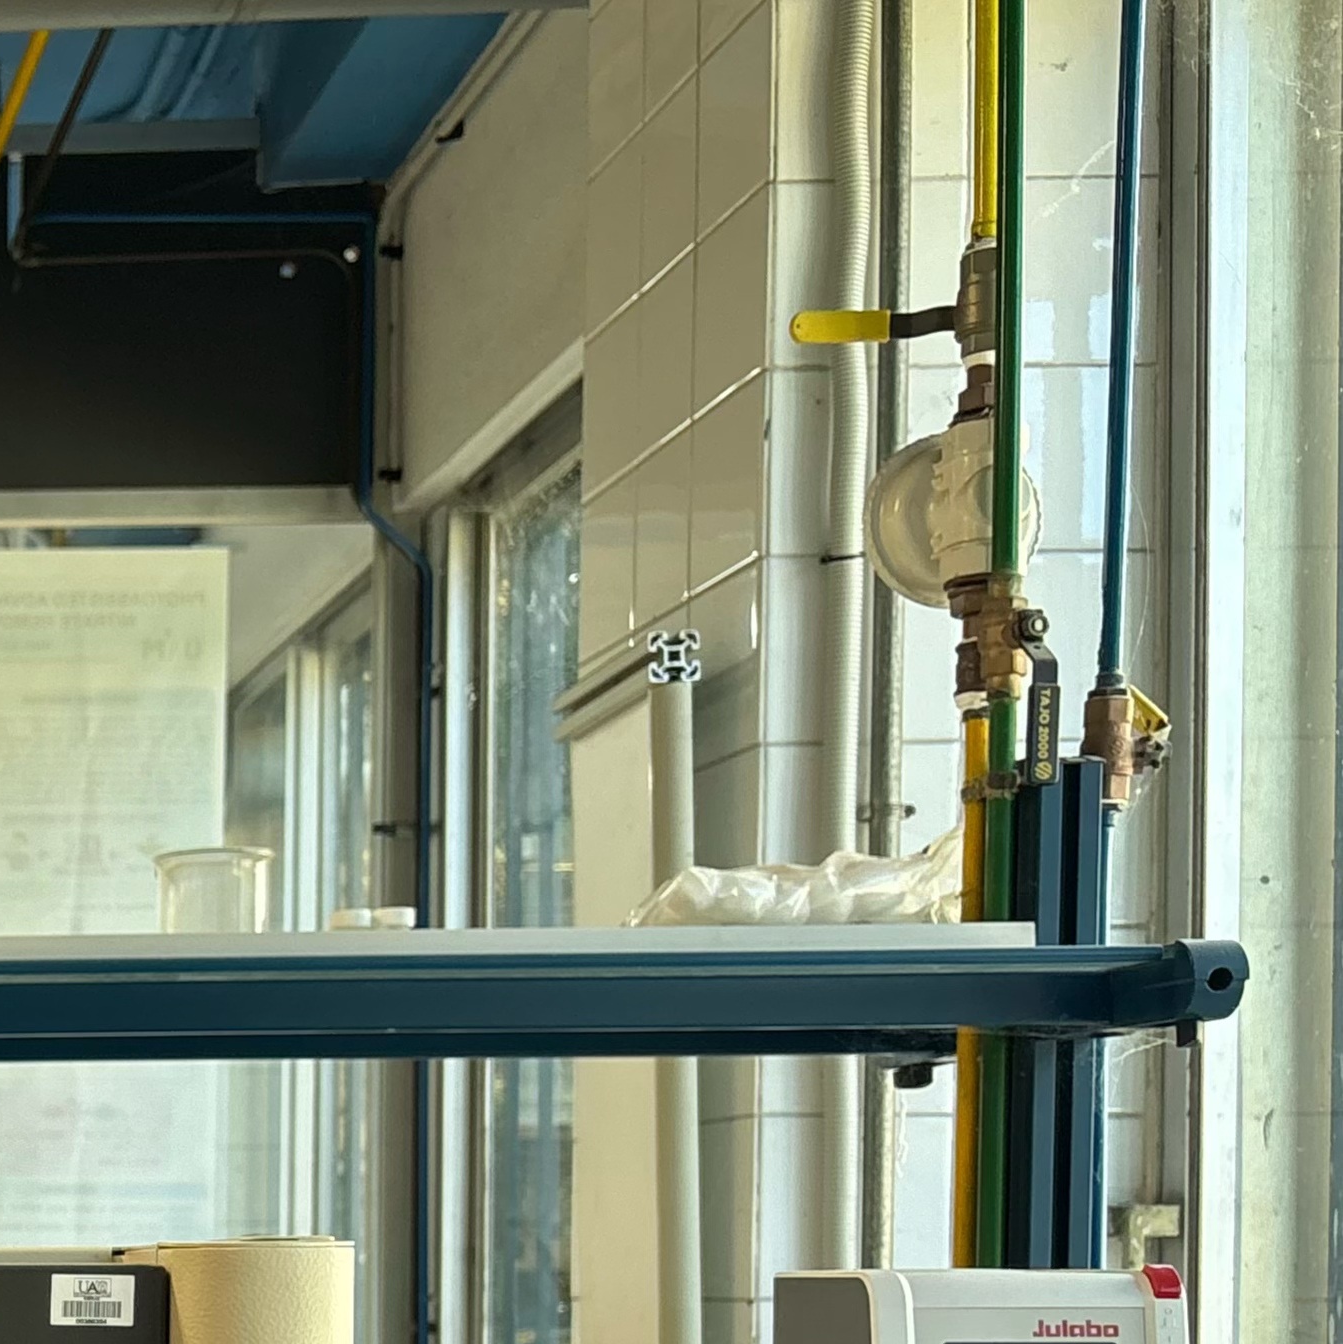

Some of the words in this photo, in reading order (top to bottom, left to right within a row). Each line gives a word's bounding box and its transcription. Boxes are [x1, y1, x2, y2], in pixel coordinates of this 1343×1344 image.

[1038, 687, 1052, 725] TAJO
[1037, 726, 1050, 760] 2000
[1032, 1319, 1120, 1338] Julabo
